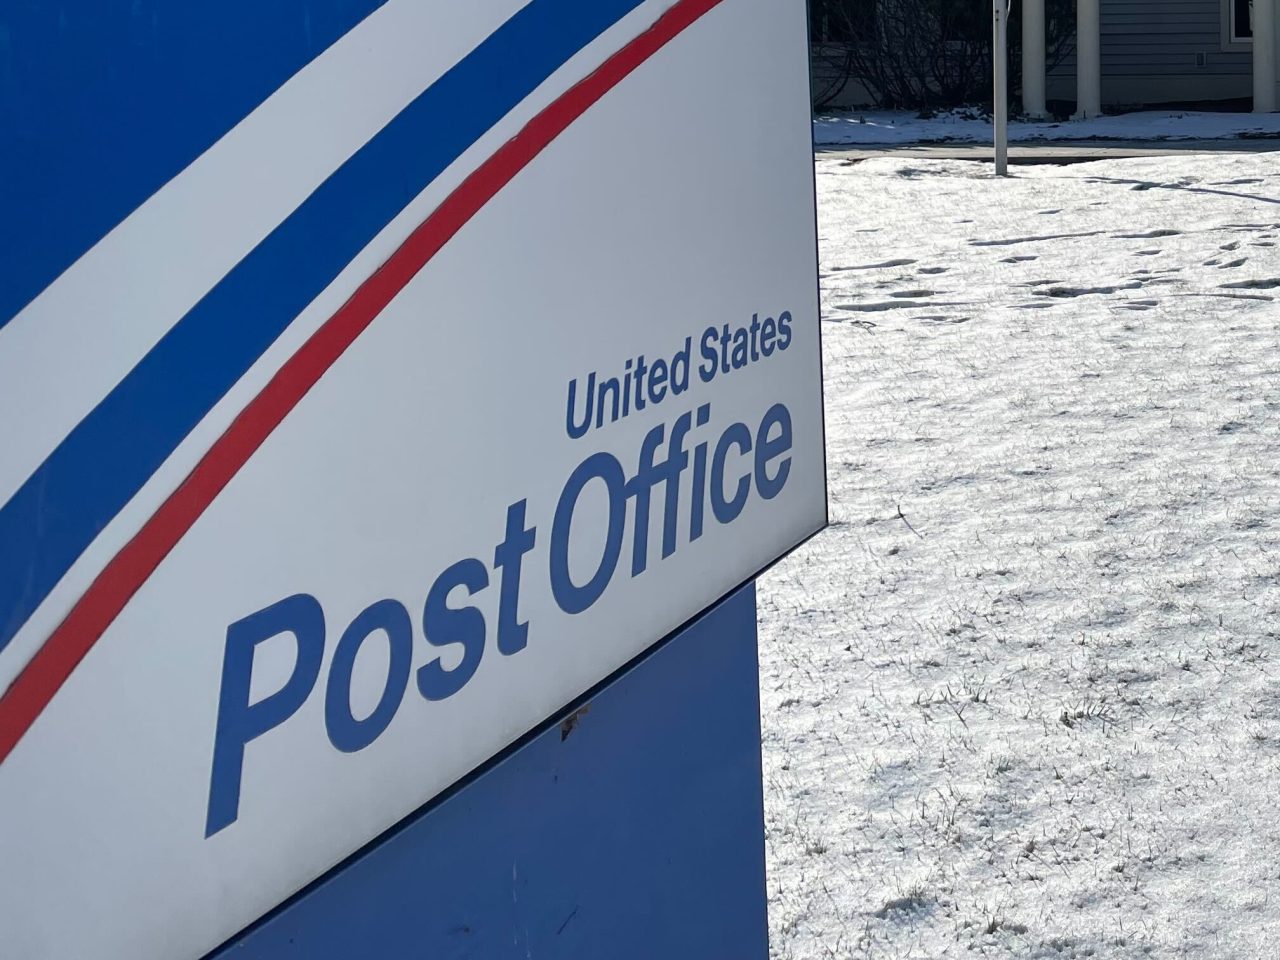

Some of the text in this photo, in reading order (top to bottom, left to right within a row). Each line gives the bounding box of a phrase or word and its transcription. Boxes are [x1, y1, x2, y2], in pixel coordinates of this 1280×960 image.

[566, 310, 793, 440] United States
[205, 402, 793, 840] Post Office
